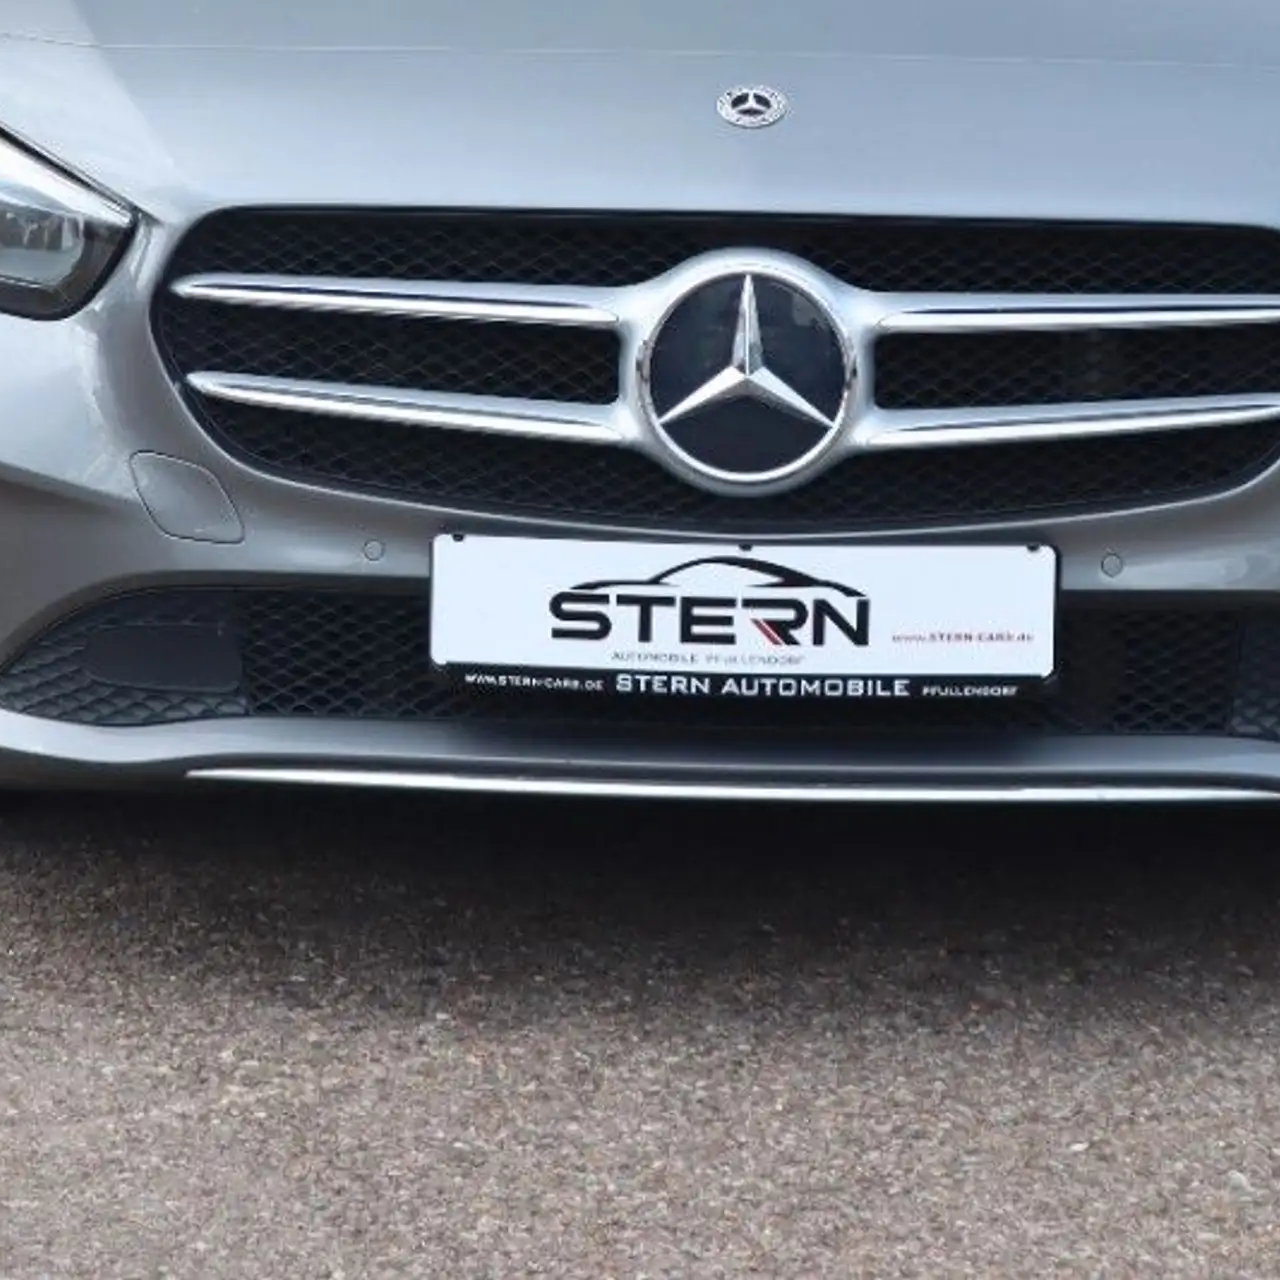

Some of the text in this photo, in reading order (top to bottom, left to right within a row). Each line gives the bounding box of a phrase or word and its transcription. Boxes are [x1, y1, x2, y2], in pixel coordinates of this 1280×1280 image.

[548, 590, 870, 647] STERN
[616, 672, 711, 696] STERN
[721, 676, 911, 698] AUTOMOBILE
